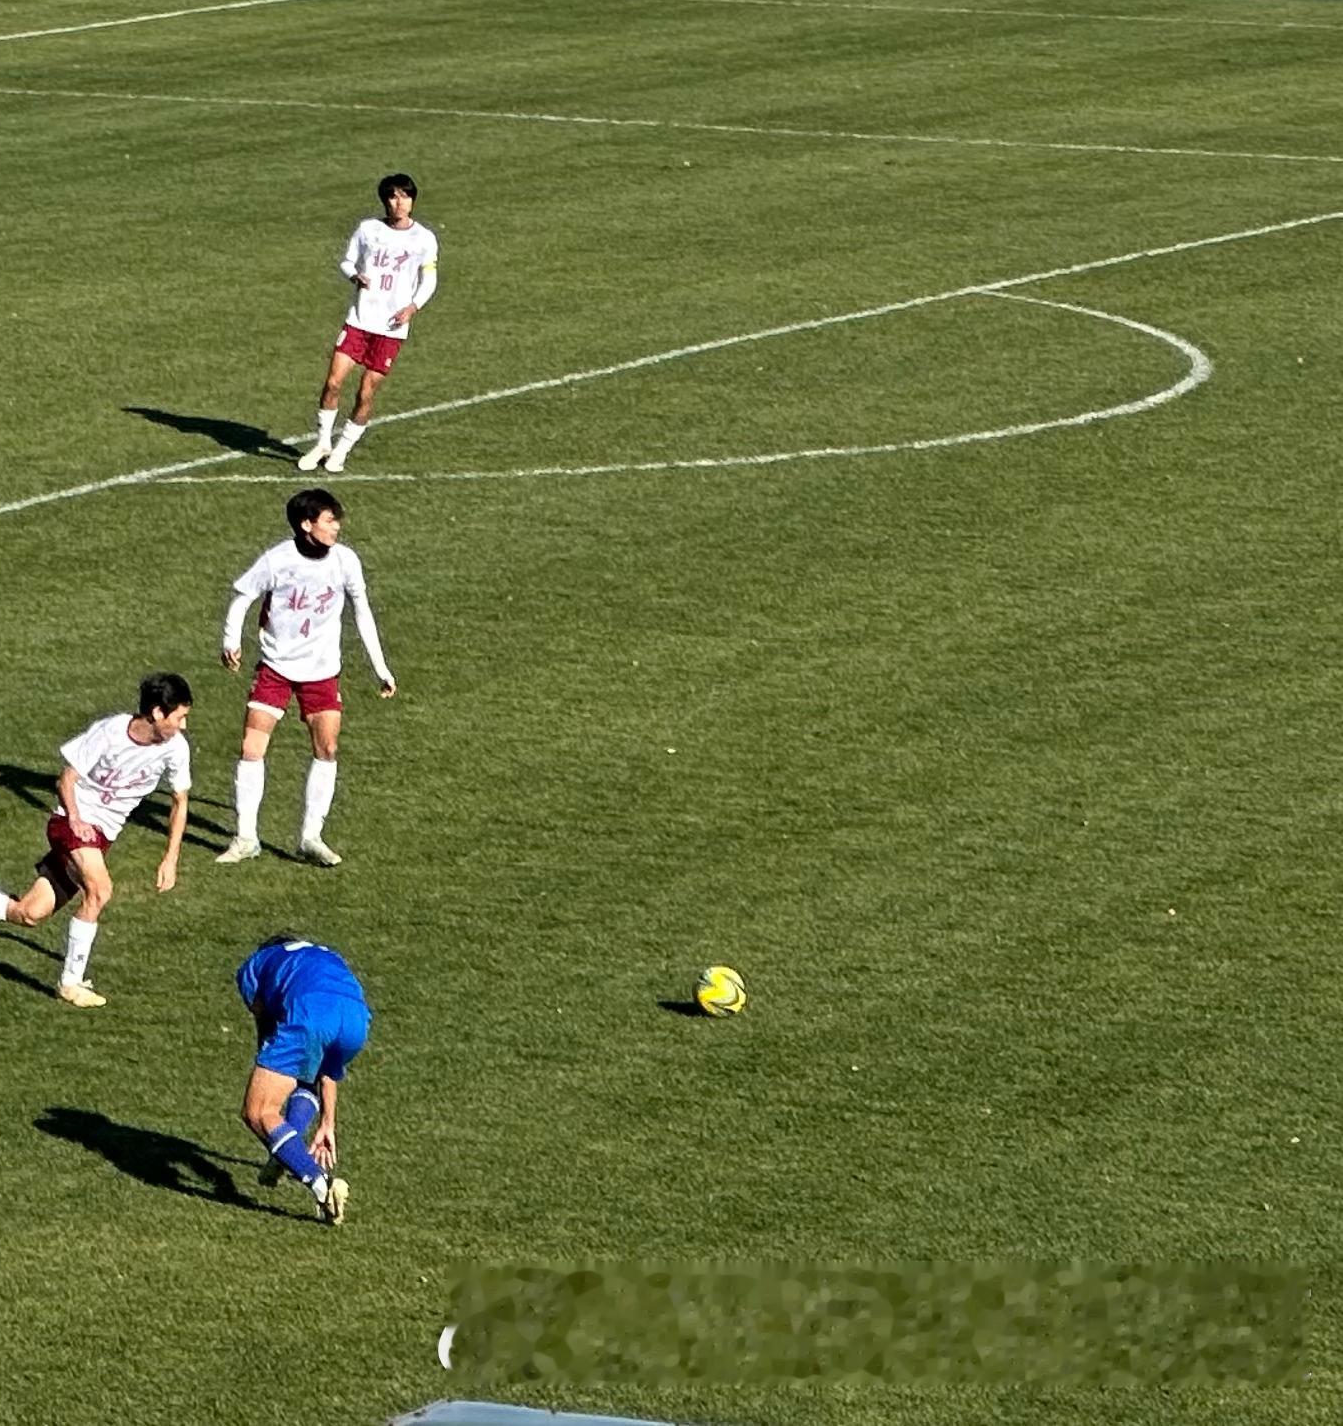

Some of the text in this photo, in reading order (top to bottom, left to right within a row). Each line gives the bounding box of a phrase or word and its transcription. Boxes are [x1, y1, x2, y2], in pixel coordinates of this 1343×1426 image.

[379, 274, 394, 292] 10
[287, 586, 336, 615] 北京
[299, 618, 312, 639] 4
